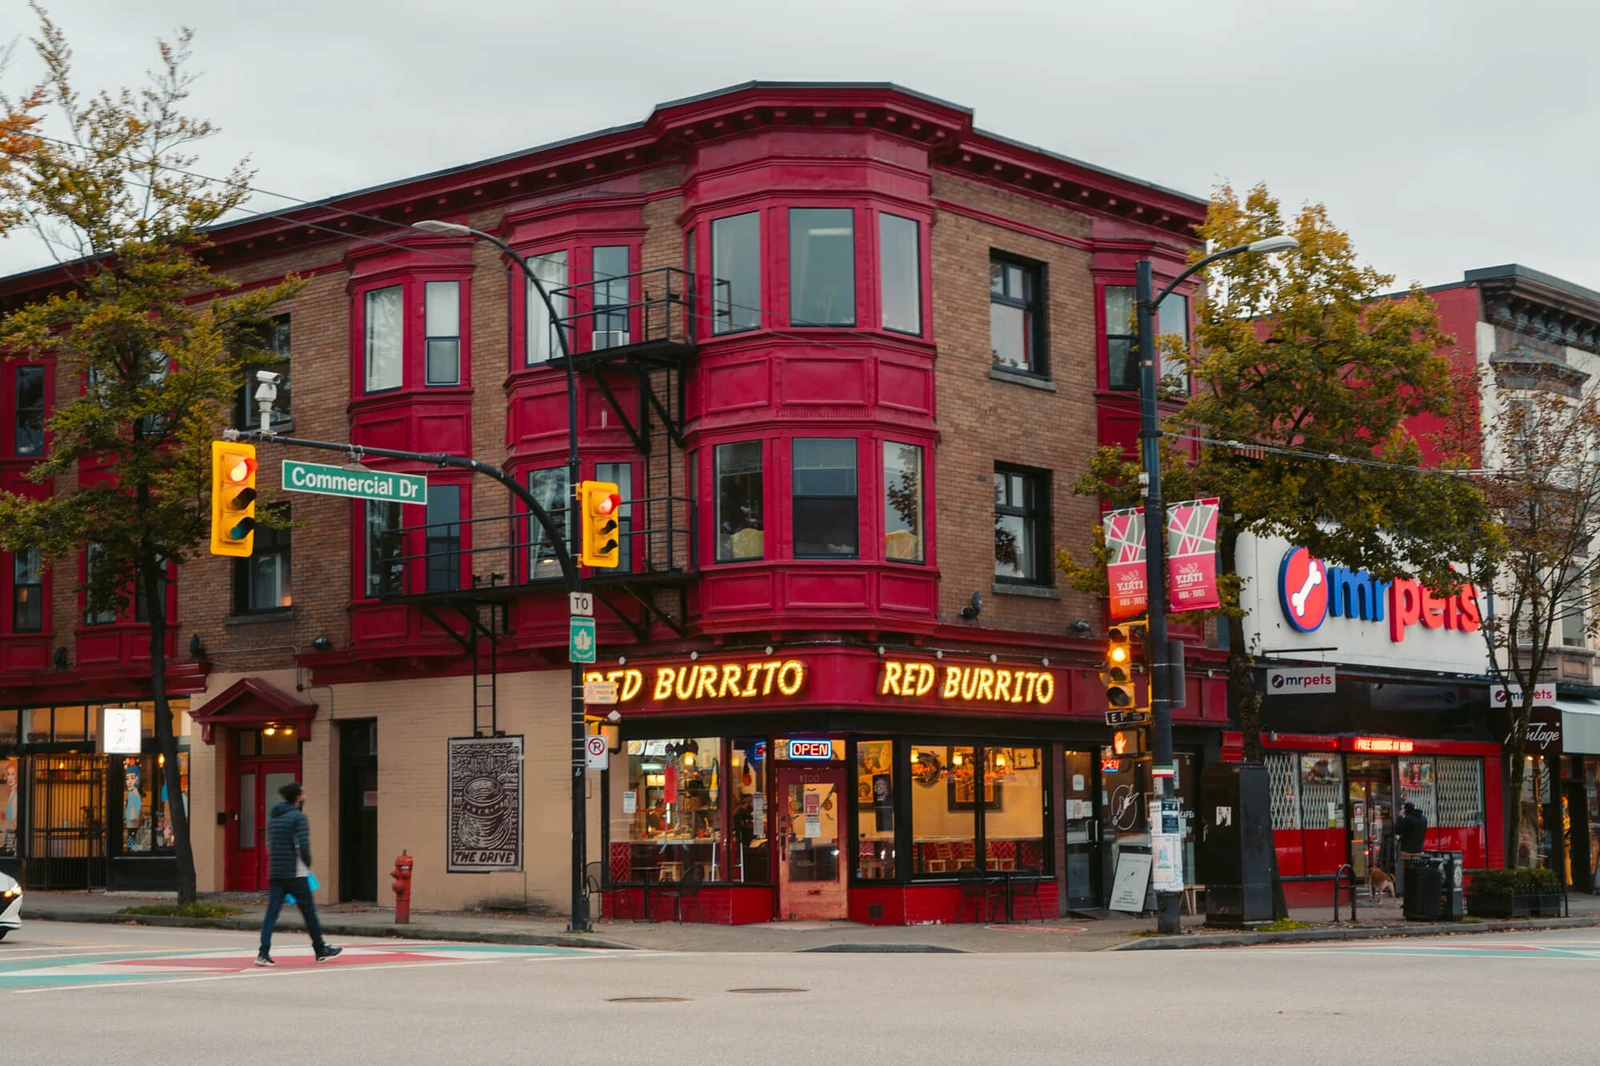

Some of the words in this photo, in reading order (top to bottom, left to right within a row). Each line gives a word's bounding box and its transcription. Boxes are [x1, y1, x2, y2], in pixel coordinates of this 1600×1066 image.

[292, 466, 392, 495] Commercial
[400, 479, 418, 498] Dr
[574, 597, 589, 610] TO
[653, 659, 804, 701] BURRITO
[882, 661, 935, 697] RED
[943, 665, 1055, 705] BURRITO
[1286, 674, 1331, 688] mrpets
[793, 743, 828, 756] OPEN
[454, 851, 477, 863] THE
[478, 851, 513, 863] DRIVE
